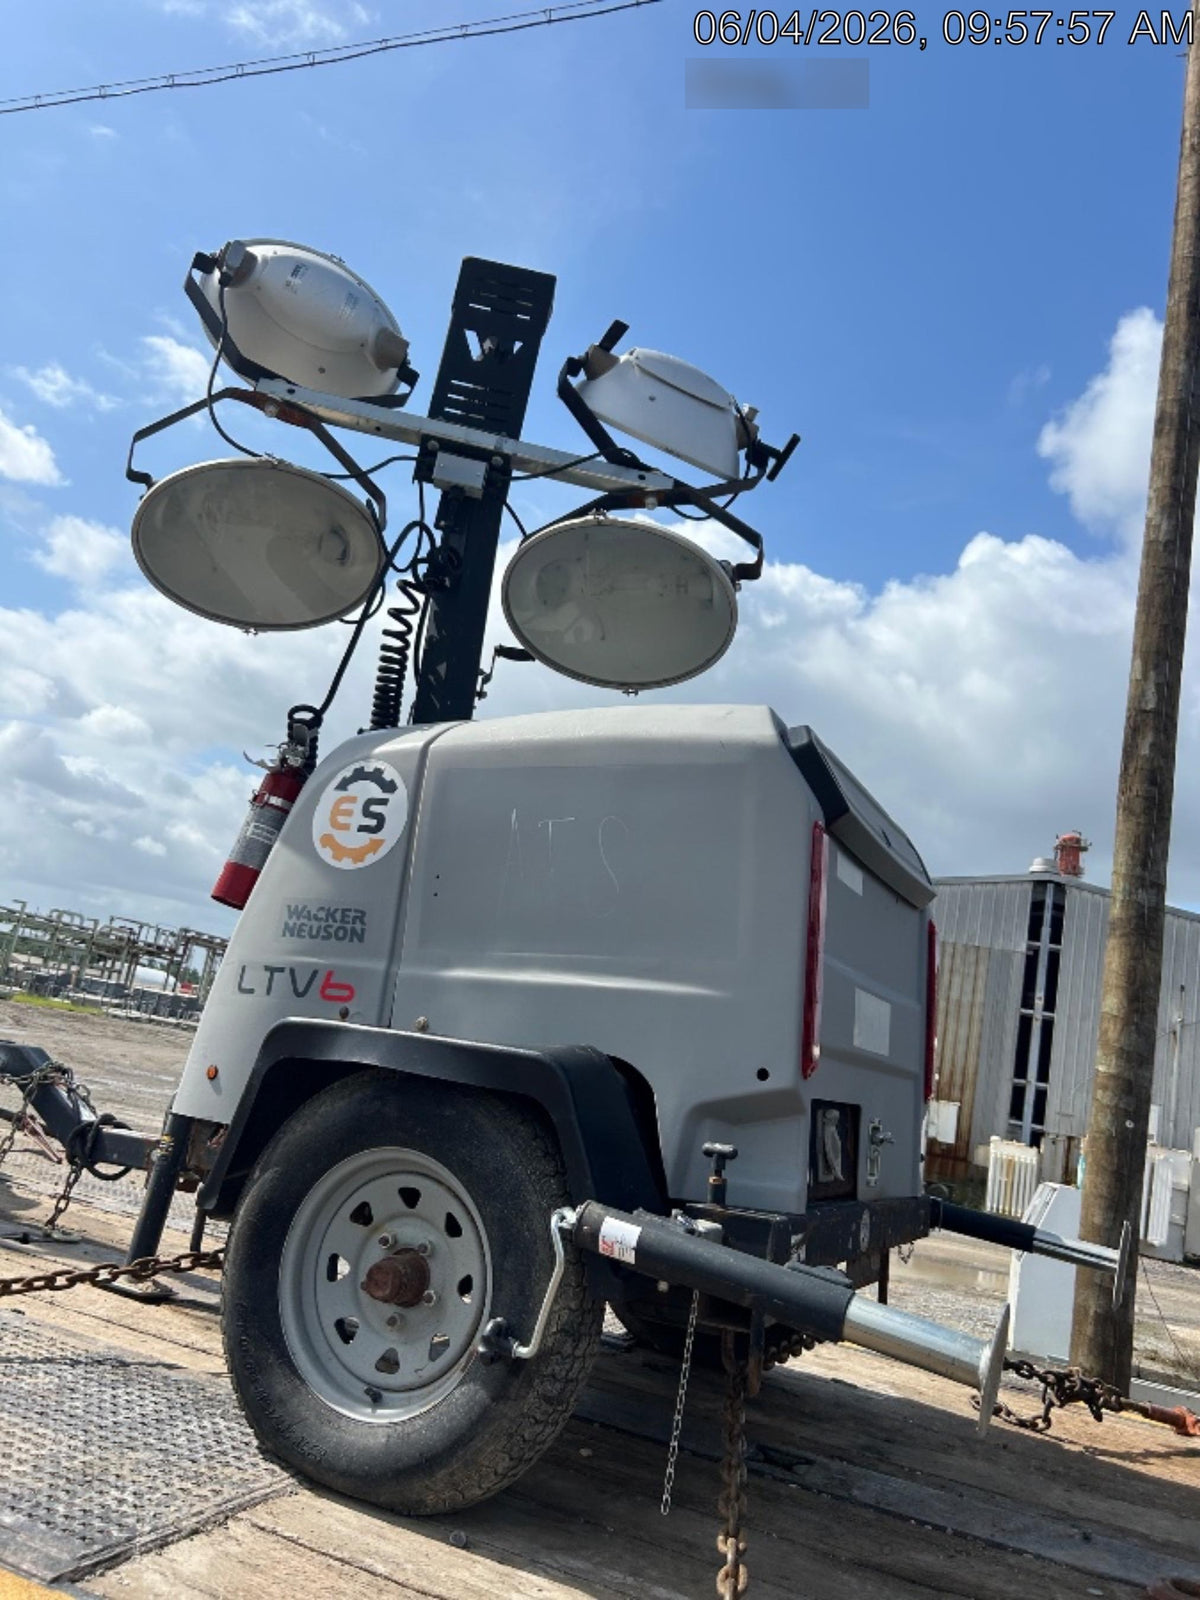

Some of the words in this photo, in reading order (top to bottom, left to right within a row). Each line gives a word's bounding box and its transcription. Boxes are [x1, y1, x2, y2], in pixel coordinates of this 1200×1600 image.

[329, 796, 390, 834] ES
[286, 905, 367, 926] WACKER
[282, 922, 366, 943] NEUSON
[237, 965, 356, 1003] LTV6
